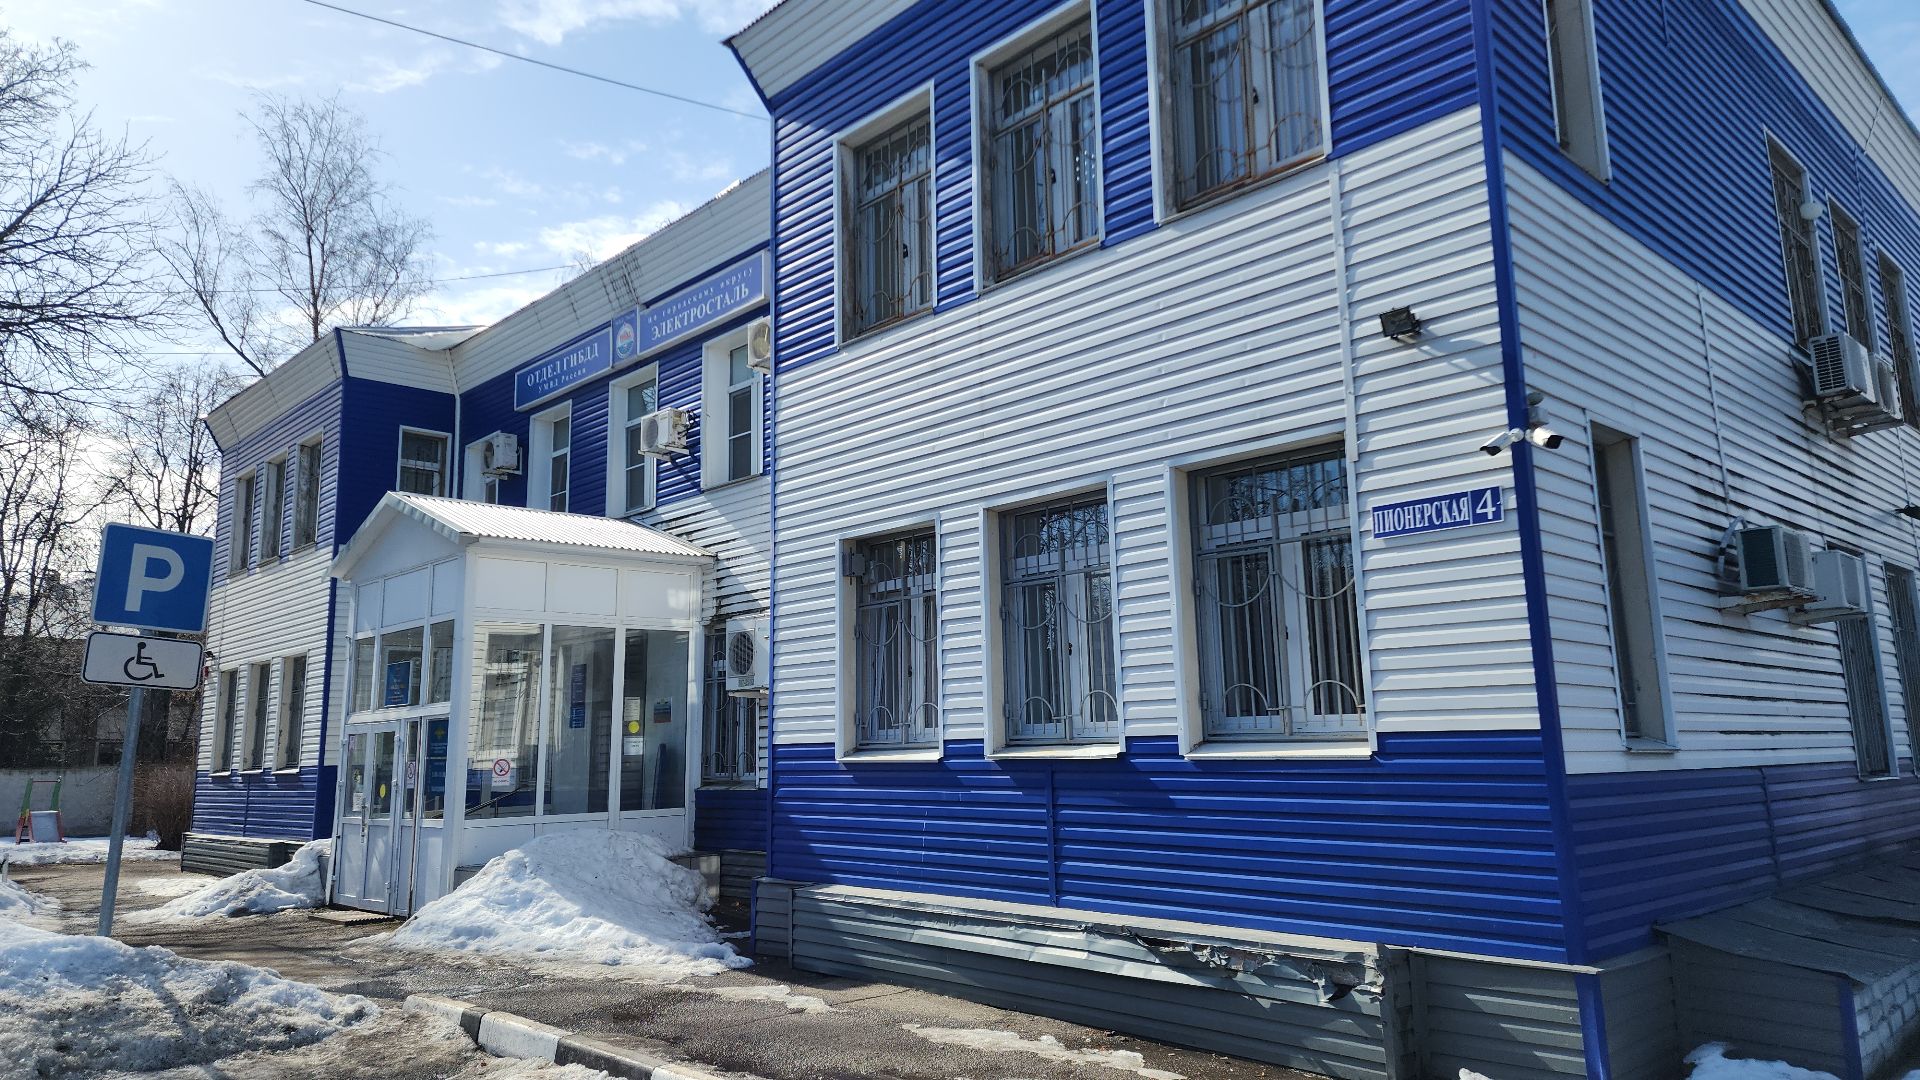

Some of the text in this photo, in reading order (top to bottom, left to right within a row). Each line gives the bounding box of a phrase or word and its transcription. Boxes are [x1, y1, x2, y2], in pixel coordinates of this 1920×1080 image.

[651, 283, 749, 341] ЭЛЕКТРОСТАЛЬ
[527, 343, 599, 387] ОТДЕЛ ГИБДД
[538, 378, 559, 393] УМВД
[1373, 489, 1496, 534] ПИОНЕРСКАЯ 4
